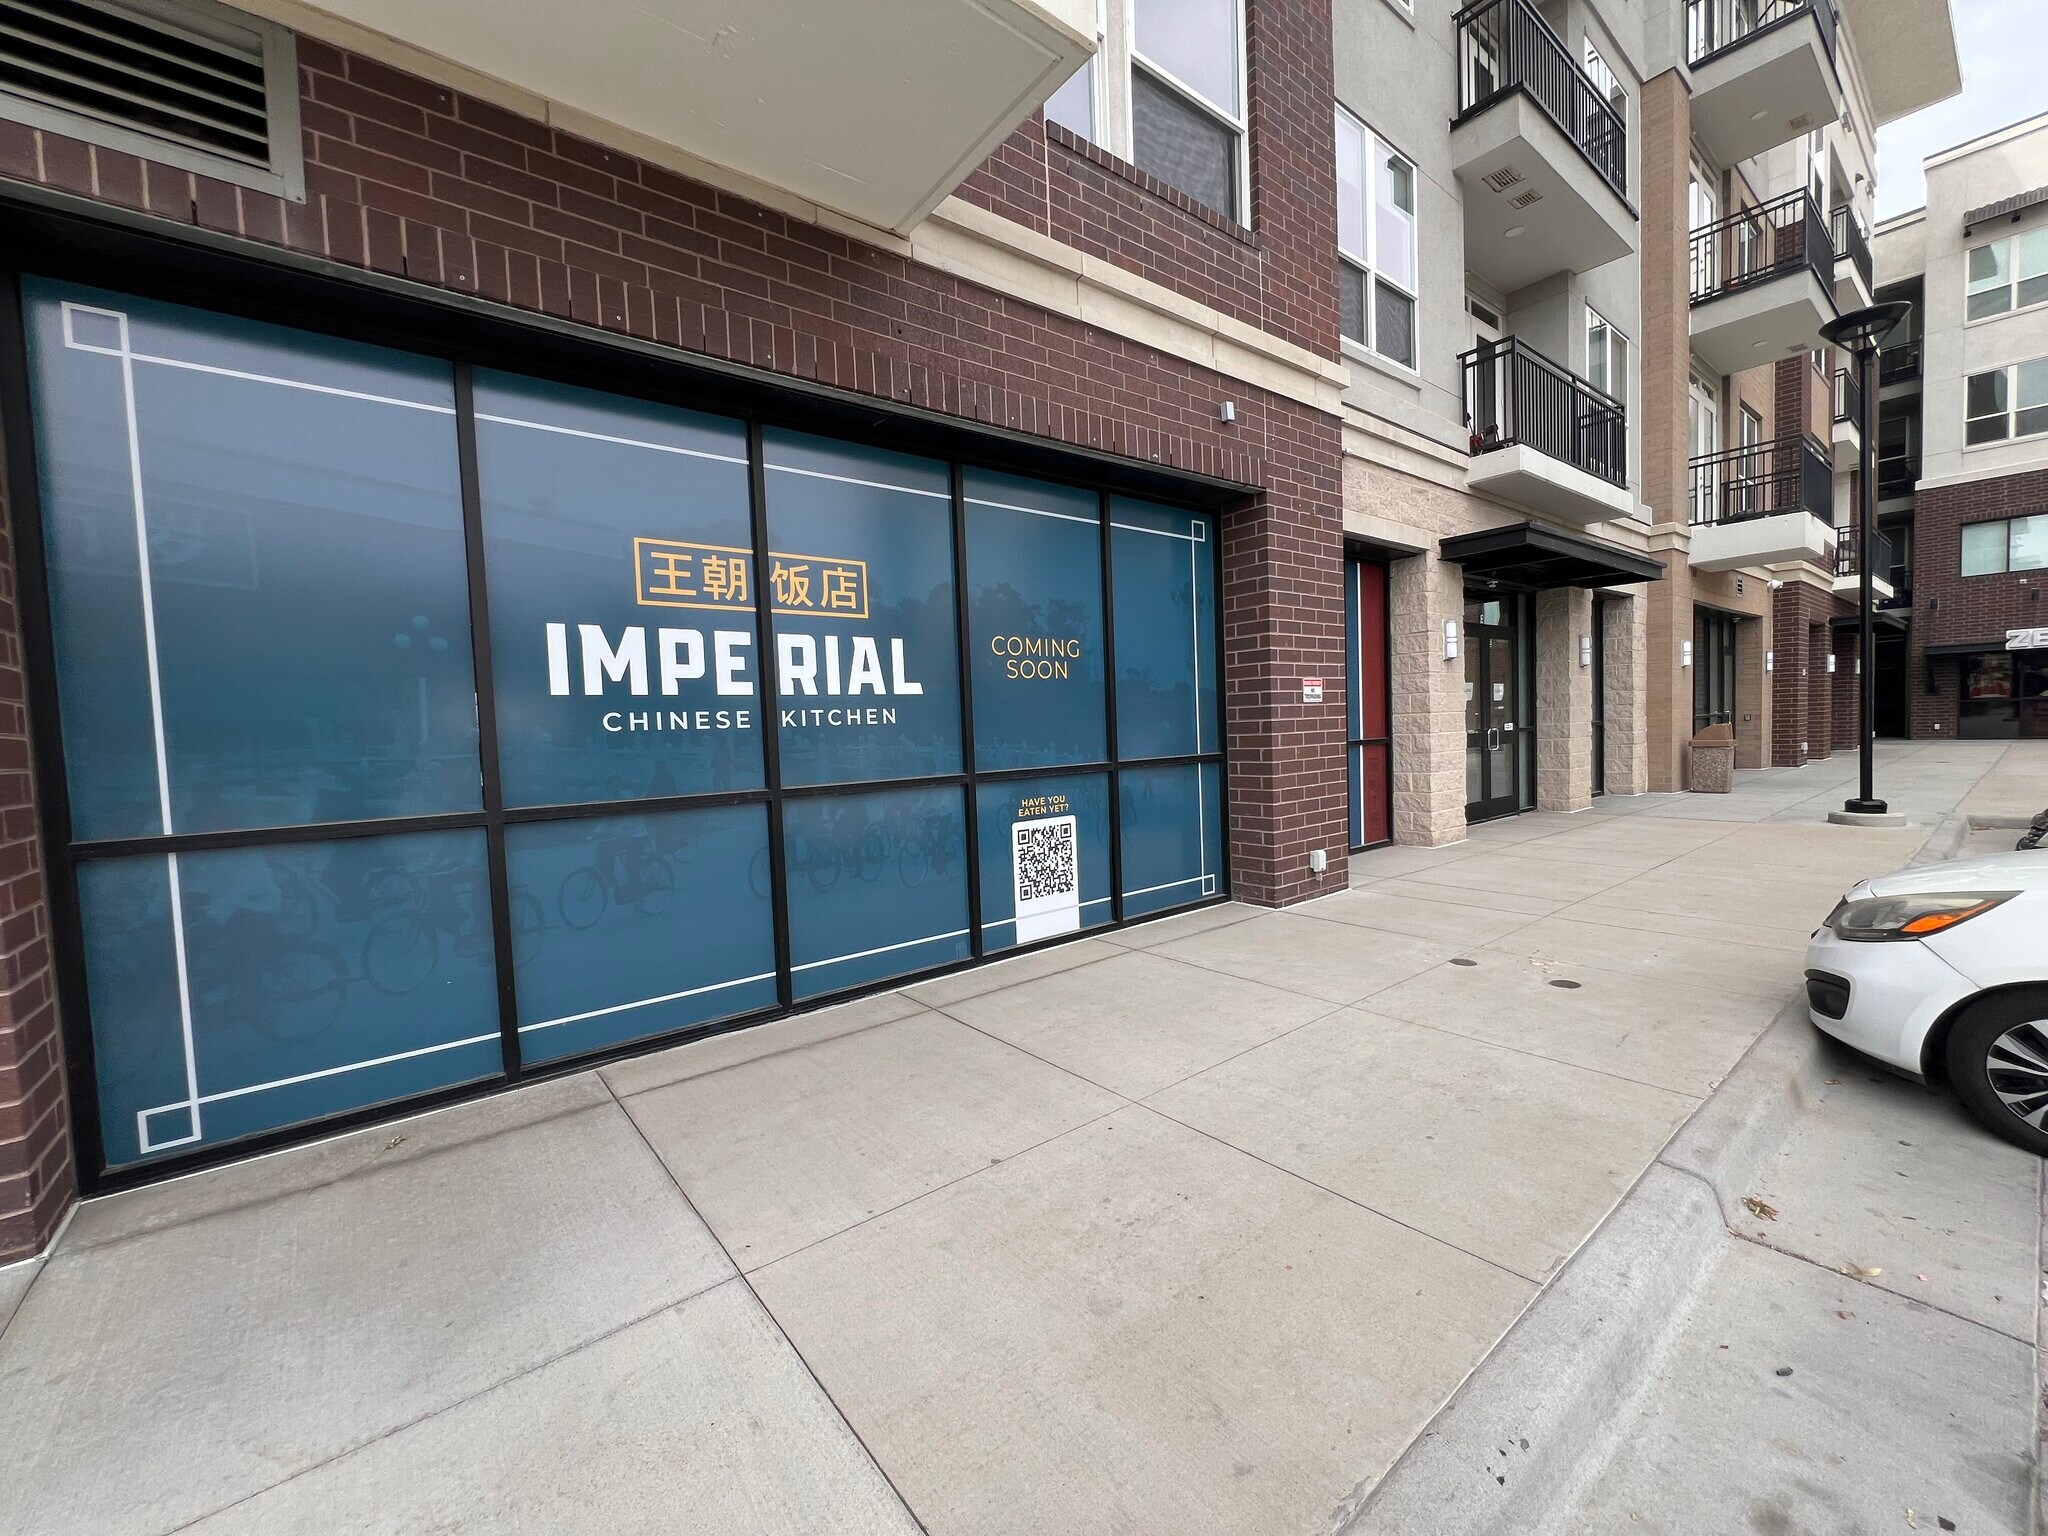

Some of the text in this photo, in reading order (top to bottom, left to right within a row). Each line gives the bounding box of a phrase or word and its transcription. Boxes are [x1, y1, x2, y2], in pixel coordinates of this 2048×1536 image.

[649, 551, 858, 609] 王朝饭店
[991, 635, 1080, 658] COMING
[546, 622, 924, 696] IMPERIAL
[1006, 659, 1068, 679] SOON
[602, 708, 897, 732] CHINESE KITCHEN
[1018, 803, 1069, 817] EATEN YET?
[1021, 795, 1066, 808] HAVE YOU
